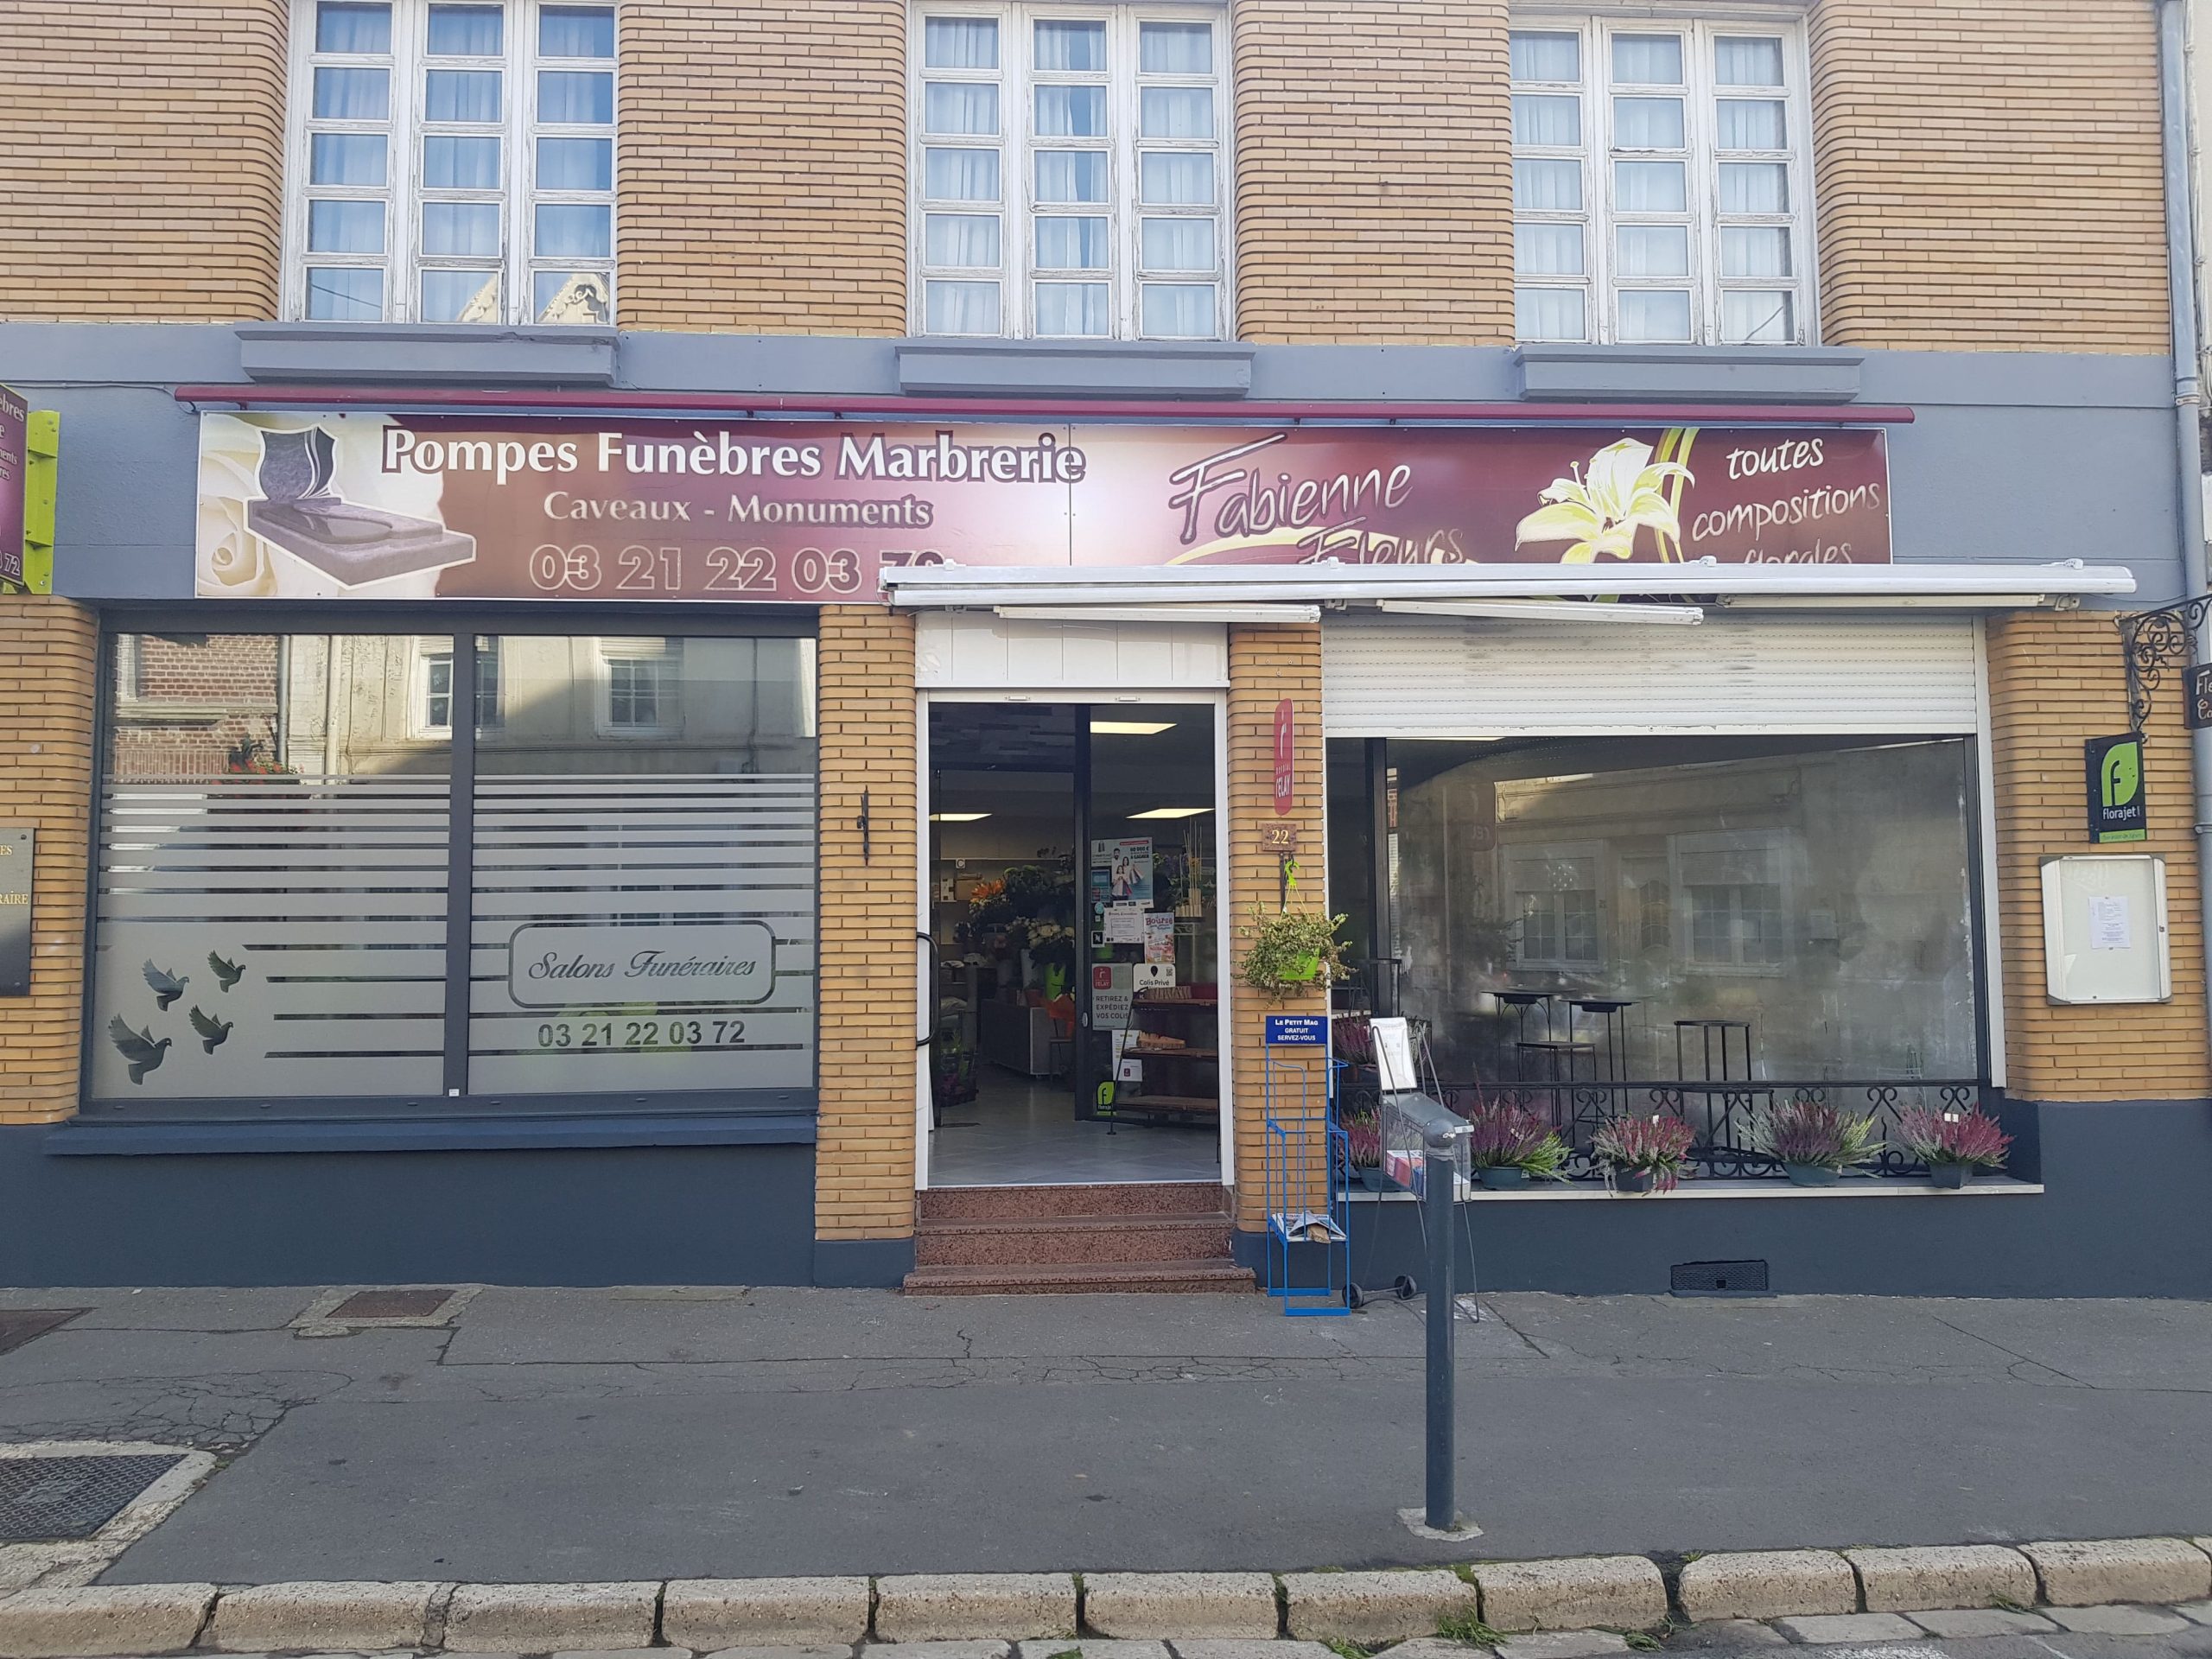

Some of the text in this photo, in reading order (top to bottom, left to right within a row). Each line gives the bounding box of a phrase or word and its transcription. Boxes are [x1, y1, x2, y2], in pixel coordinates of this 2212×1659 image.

[384, 427, 1086, 486] Pompes Funèbres Marbrerie
[1726, 437, 1824, 480] toutes
[1169, 433, 1414, 543] Fabienne
[543, 491, 691, 522] Caveaux
[728, 494, 933, 527] Monuments
[1692, 482, 1880, 541] compositions
[529, 543, 861, 594] 03 21 22 03
[2102, 806, 2137, 821] florajet
[1272, 830, 1289, 844] 22
[528, 950, 756, 980] Salons Funéraires
[538, 1020, 746, 1047] 03 21 22 03 72
